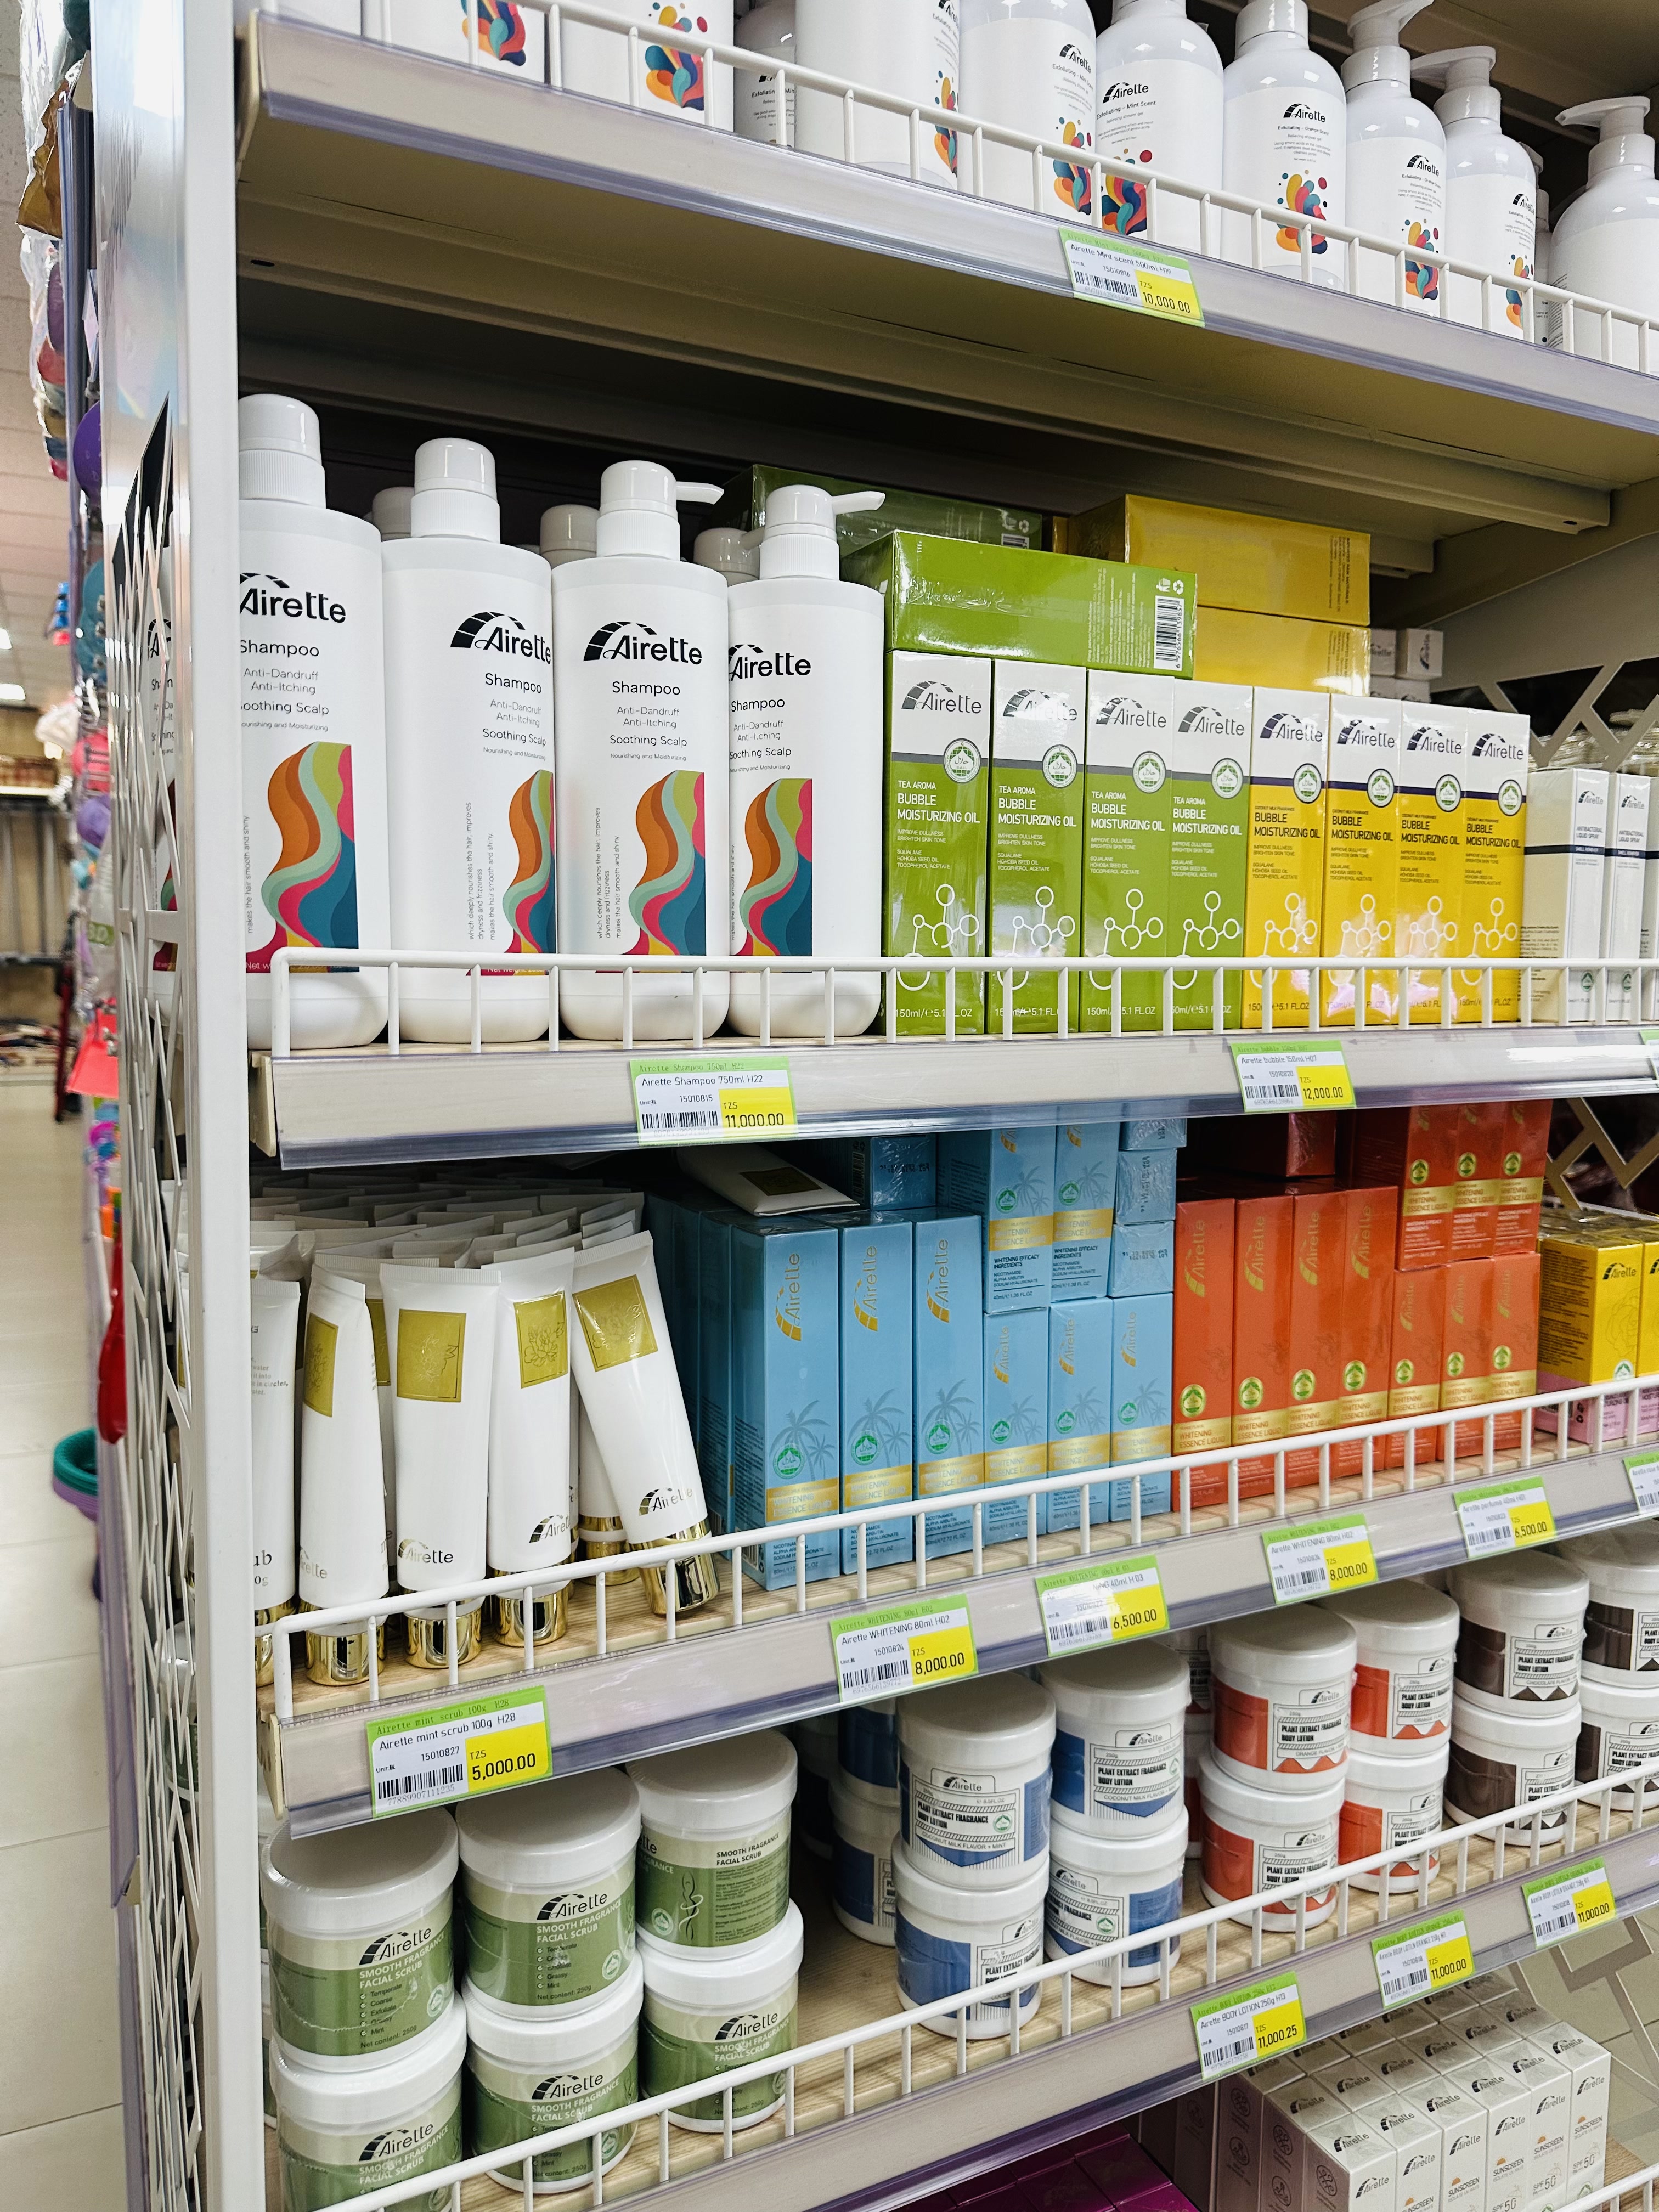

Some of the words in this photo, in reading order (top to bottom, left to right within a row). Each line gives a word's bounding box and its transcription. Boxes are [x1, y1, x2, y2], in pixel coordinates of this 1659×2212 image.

[1068, 51, 1091, 74] Airette
[1110, 84, 1149, 100] Airette
[1291, 109, 1325, 122] Airette
[1414, 161, 1439, 176] Airette
[1071, 244, 1095, 256] Airette
[1098, 250, 1113, 259] Mint
[1114, 256, 1133, 265] scent
[1136, 261, 1158, 272] 500ml
[1103, 266, 1131, 277] 15010816
[1143, 292, 1190, 313] 10,000.00
[240, 588, 346, 623] Airette
[240, 640, 319, 658] Shampoo
[475, 627, 551, 664] Airette
[603, 635, 702, 665] Airette
[244, 668, 319, 681] Anti-Dandruff
[729, 653, 811, 682] Airette
[251, 681, 315, 695] Anti-Itching
[485, 673, 541, 693] Shampoo
[612, 681, 680, 696] Shampoo
[241, 701, 291, 714] oothing
[297, 702, 329, 716] Scalp
[490, 699, 541, 715] Anti-Dandruff
[731, 699, 785, 712] Shampoo
[916, 692, 981, 714] Airette
[617, 707, 679, 716] Anti-Dandruff
[1109, 708, 1166, 728] Airette
[289, 722, 328, 732] Moisturizing
[496, 712, 540, 728] Anti-Itching
[623, 718, 676, 729] Anti-Itching
[733, 720, 783, 731] Anti-Dandruff
[1189, 716, 1245, 736] Airette
[483, 729, 526, 743] Soothing
[529, 734, 546, 747] Scalp
[737, 732, 781, 742] Anti-Itching
[1271, 723, 1322, 742] Airette
[610, 735, 657, 746] Soothing
[661, 736, 687, 747] Scalp
[1417, 736, 1462, 754] Airette
[654, 753, 686, 761] Moisturizing
[730, 749, 762, 760] Soothing
[765, 747, 792, 757] Scalp
[1482, 742, 1523, 760] Airette
[898, 781, 911, 789] TEA
[913, 781, 936, 790] AROMA
[999, 786, 1011, 794] TEA
[1013, 786, 1035, 795] AROMA
[898, 793, 936, 806] BUBBLE
[998, 798, 1036, 810] BUBBLE
[898, 809, 962, 823] MOISTURIZING
[964, 812, 980, 823] OIL
[1091, 803, 1126, 815] BUBBLE
[1173, 808, 1206, 820] BUBBLE
[998, 813, 1061, 826] MOISTURIZING
[1063, 816, 1077, 827] OIL
[1091, 819, 1150, 831] MOISTURIZING
[1152, 821, 1165, 832] OIL
[1255, 812, 1288, 823] BUBBLE
[1402, 820, 1430, 830] BUBBLE
[1173, 823, 1228, 835] MOISTURIZING
[1230, 826, 1242, 836] OIL
[1255, 827, 1308, 838] MOISTURIZING
[1310, 828, 1321, 838] OIL
[1401, 833, 1448, 844] MOISTURIZING
[1450, 836, 1460, 845] OIL
[675, 1077, 715, 1086] Shampoo
[718, 1075, 745, 1084] 750ml
[747, 1075, 763, 1083] H22
[679, 1094, 713, 1103] 15010815
[1304, 1087, 1343, 1100] 12,000.00
[862, 1246, 877, 1316] Airette
[935, 1239, 949, 1307] Airette
[785, 1253, 800, 1326] Airette
[1180, 1430, 1211, 1439] WHITENING
[1180, 1438, 1205, 1448] ESSENCE
[1207, 1436, 1225, 1444] LIQUID
[1515, 1521, 1547, 1538] 6,500.00
[403, 1548, 454, 1564] Airette
[1330, 1562, 1367, 1581] 8,000.00
[1111, 1578, 1127, 1587] 40ml
[1113, 1609, 1157, 1629] 6,500.00
[842, 1634, 867, 1645] Airette
[870, 1623, 913, 1639] WHITENING
[915, 1619, 934, 1629] 80ml
[935, 1615, 950, 1625] H02
[874, 1644, 904, 1656] 15010824
[912, 1647, 926, 1657] TZS
[915, 1652, 964, 1675] 8,000.00
[377, 1721, 410, 1735] Airette
[415, 1716, 433, 1726] mint
[440, 1710, 464, 1721] scrub
[468, 1705, 487, 1715] 100g
[495, 1700, 509, 1708] H28
[380, 1736, 413, 1751] Airette
[417, 1730, 438, 1743] mint
[441, 1724, 469, 1737] scrub
[472, 1719, 492, 1730] 100g
[498, 1713, 516, 1724] H28
[421, 1746, 460, 1762] 15010827
[470, 1750, 487, 1760] TZS
[472, 1753, 536, 1781] 5,000.00
[1098, 1767, 1115, 1776] PLANT
[1116, 1767, 1140, 1776] EXTRACT
[950, 1781, 982, 1791] Airette
[716, 1848, 747, 1858] SMOOTH
[748, 1832, 779, 1852] FRAGRANCE
[742, 1851, 761, 1861] SCRUB
[550, 1893, 607, 1918] Airette
[1578, 1903, 1610, 1923] 11,000.00
[537, 1921, 577, 1933] SMOOTH
[580, 1898, 622, 1927] FRAGRANCE
[537, 1933, 568, 1943] FACIAL
[571, 1923, 598, 1938] SCRUB
[374, 1928, 431, 1961] Airette
[359, 1961, 402, 1979] SMOOTH
[404, 1931, 444, 1966] FRAGRANCE
[360, 1975, 393, 1989] FACIAL
[395, 1961, 422, 1979] SCRUB
[1431, 1959, 1466, 1980] 11,000.00
[1201, 2018, 1221, 2029] Airette
[1222, 2011, 1237, 2021] BODY
[1238, 2002, 1260, 2015] LOTION
[1261, 1998, 1275, 2007] 250g
[1227, 2023, 1249, 2036] 15010817
[1257, 2024, 1297, 2049] 11,000.25
[544, 2075, 603, 2098] Airette
[1574, 2116, 1602, 2134] SUNSCREEN
[373, 2124, 433, 2157] Airette
[1584, 2154, 1595, 2168] 50
[1448, 2177, 1480, 2197] SUNSCREEN
